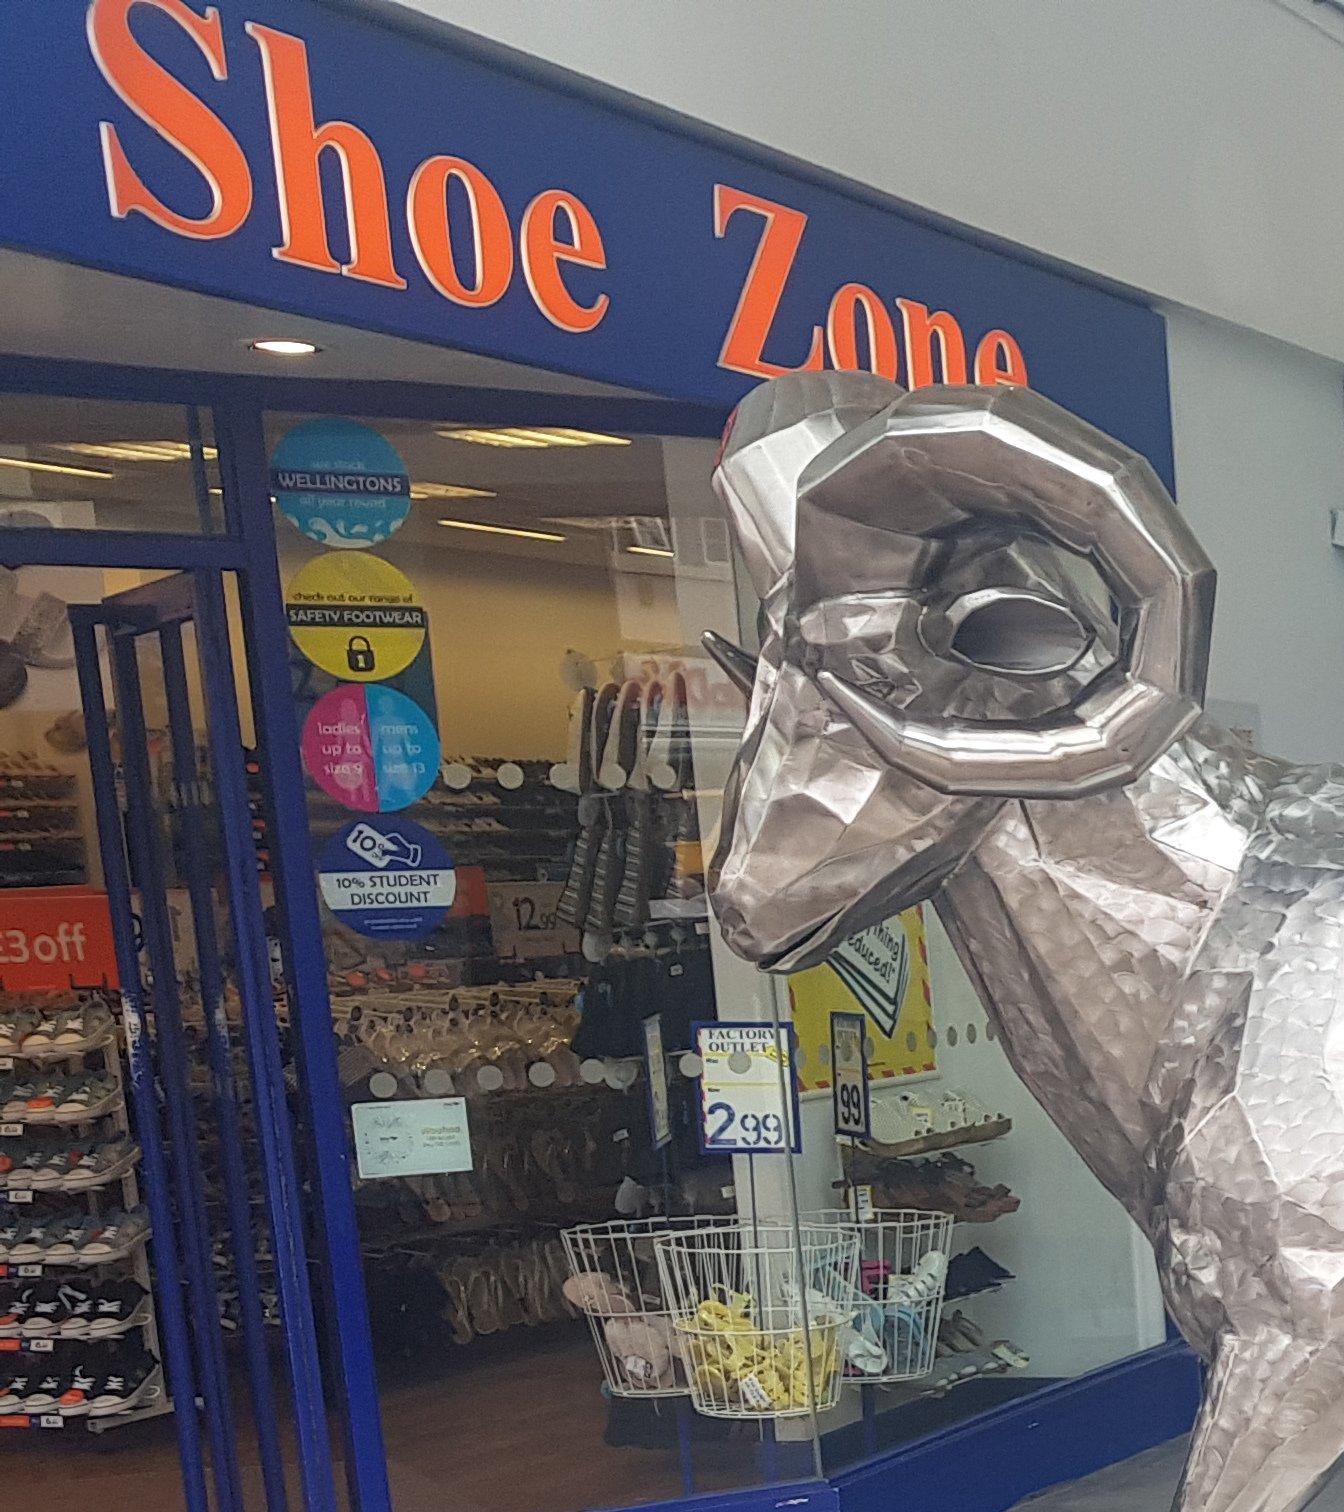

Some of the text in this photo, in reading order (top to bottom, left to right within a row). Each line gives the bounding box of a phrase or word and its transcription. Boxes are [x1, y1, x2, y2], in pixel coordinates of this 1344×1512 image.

[85, 0, 1028, 392] Shoe Zone
[277, 472, 402, 492] WELLINGTONS
[289, 609, 423, 625] SAFETY FOOTWEAR
[321, 741, 362, 757] up to
[407, 741, 421, 755] to
[336, 873, 440, 889] 10% STUDENT
[350, 890, 431, 906] DISCOUNT
[708, 1028, 777, 1041] FACTORY
[708, 1041, 769, 1053] OUTLET
